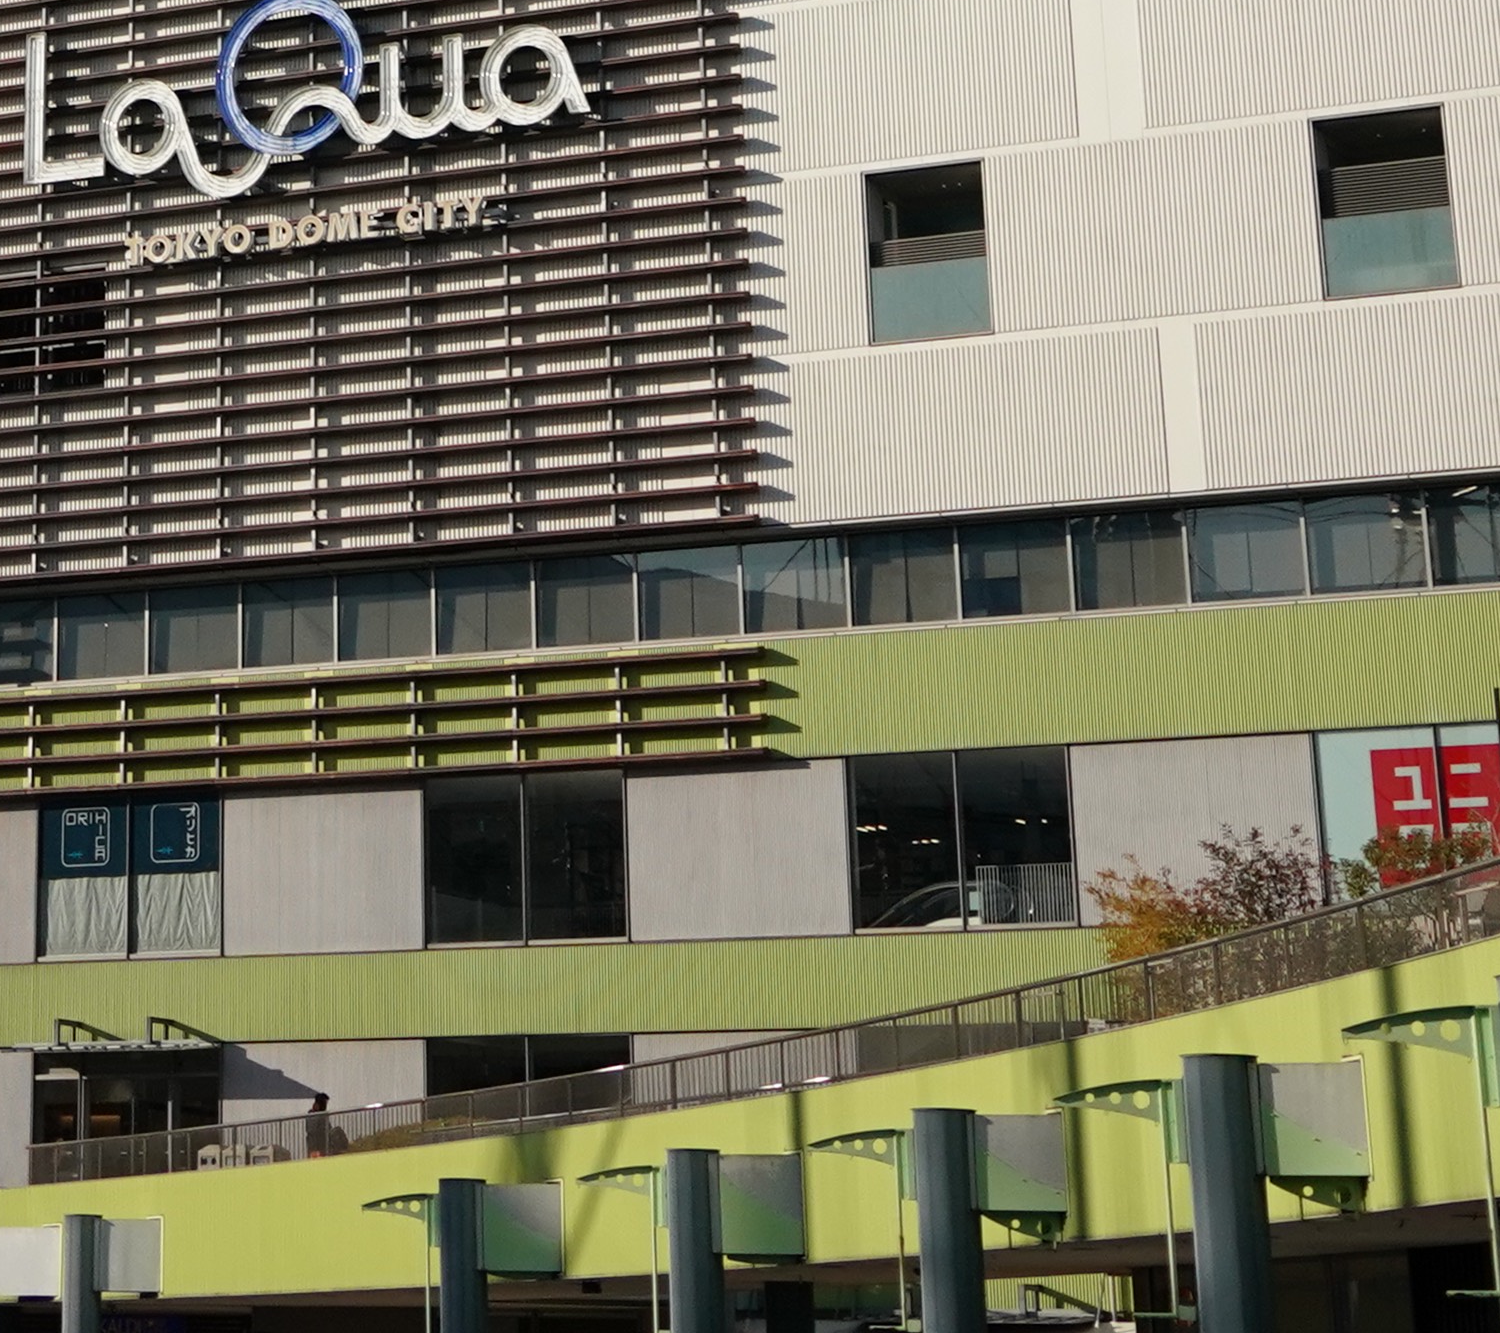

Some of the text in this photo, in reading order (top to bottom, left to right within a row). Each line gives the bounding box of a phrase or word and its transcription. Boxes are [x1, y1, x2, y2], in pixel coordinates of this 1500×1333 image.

[124, 196, 484, 266] TOKYO DOME CITY
[1392, 762, 1489, 811] ユニ
